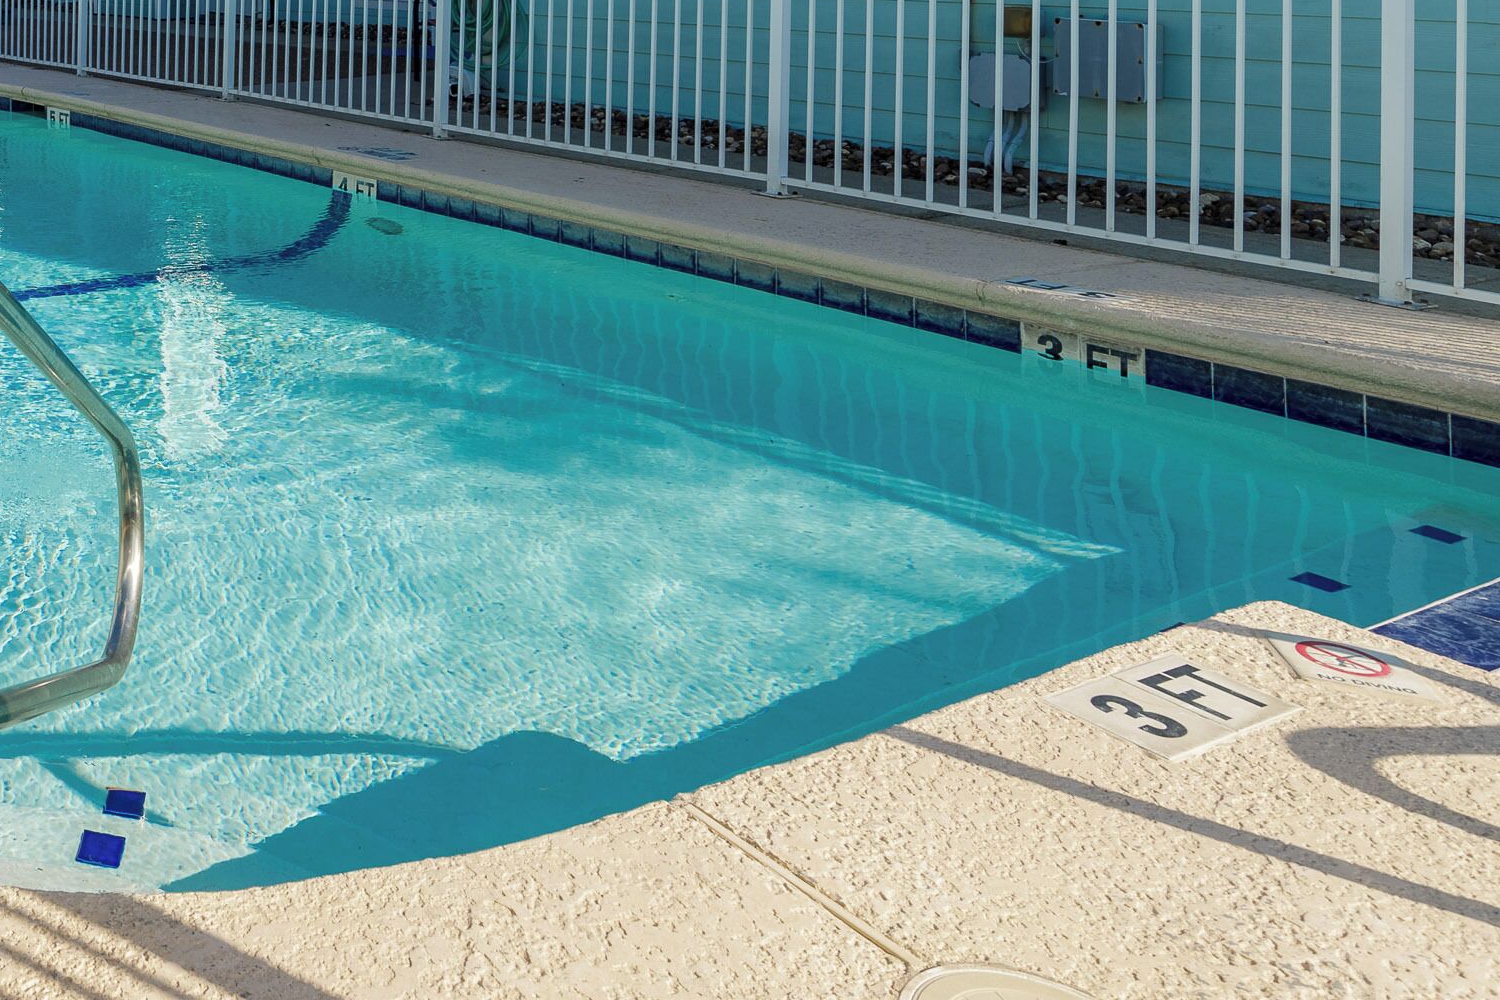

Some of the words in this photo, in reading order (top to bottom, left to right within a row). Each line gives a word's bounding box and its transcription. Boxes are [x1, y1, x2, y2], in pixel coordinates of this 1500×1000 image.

[59, 111, 69, 124] FT
[338, 177, 348, 191] 4
[356, 180, 375, 197] FT
[1037, 334, 1063, 361] 3
[1086, 343, 1137, 378] FT
[1138, 664, 1268, 721] FT
[1317, 673, 1346, 682] NO
[1351, 679, 1419, 695] DIVING
[1090, 694, 1188, 738] 3
